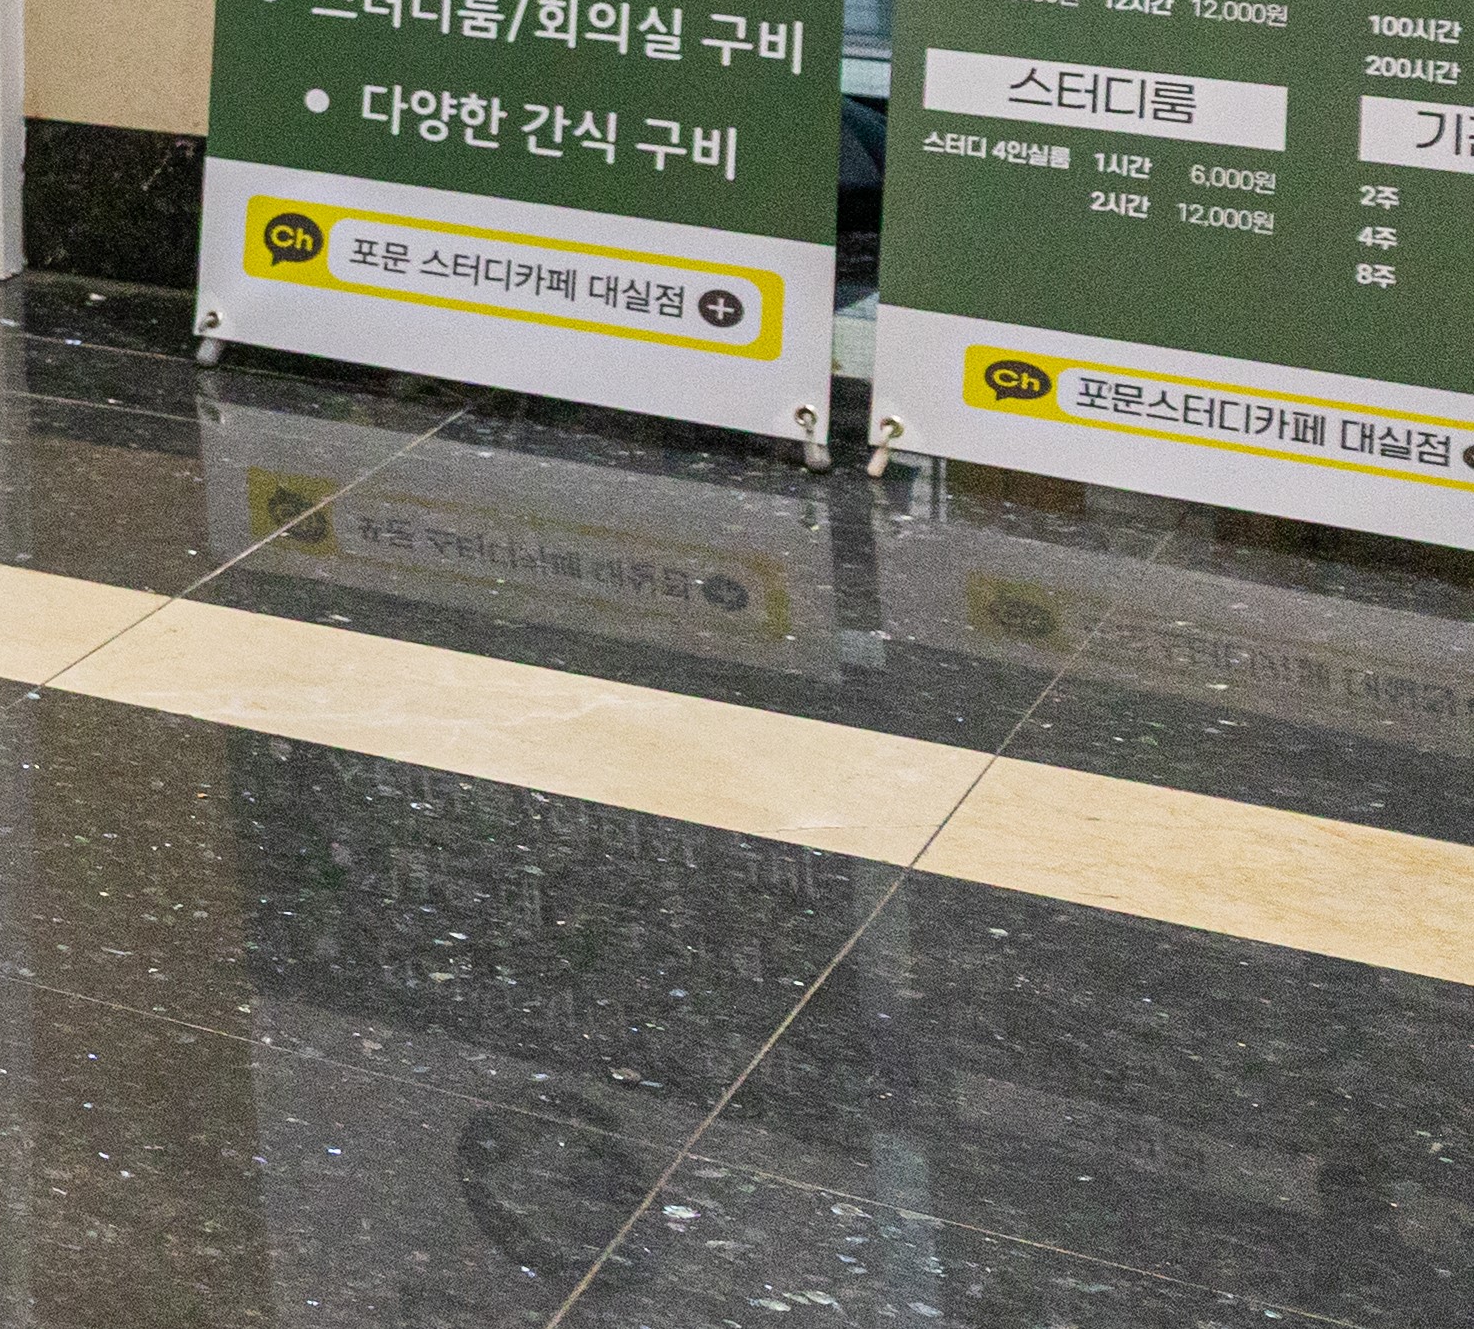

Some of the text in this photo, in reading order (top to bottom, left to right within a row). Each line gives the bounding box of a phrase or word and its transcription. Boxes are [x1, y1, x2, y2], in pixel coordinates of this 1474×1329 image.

[699, 11, 805, 76] 구비
[1369, 16, 1462, 44] 100시간
[1365, 55, 1461, 84] 200시간
[1008, 68, 1197, 124] 스터디룸
[361, 83, 739, 181] 다양한 간식 구비
[923, 133, 987, 158] 스터디
[1094, 153, 1152, 179] 1시간
[1190, 164, 1276, 194] 6,000원
[1090, 192, 1275, 234] 2시간 12,000원
[1360, 185, 1399, 209] 2주
[1357, 226, 1397, 251] 4주
[270, 225, 687, 321] Ch 포문 스터디카페 대실점
[1356, 265, 1397, 289] 8주
[992, 369, 1451, 467] Ch 포문스터디카페 대실점
